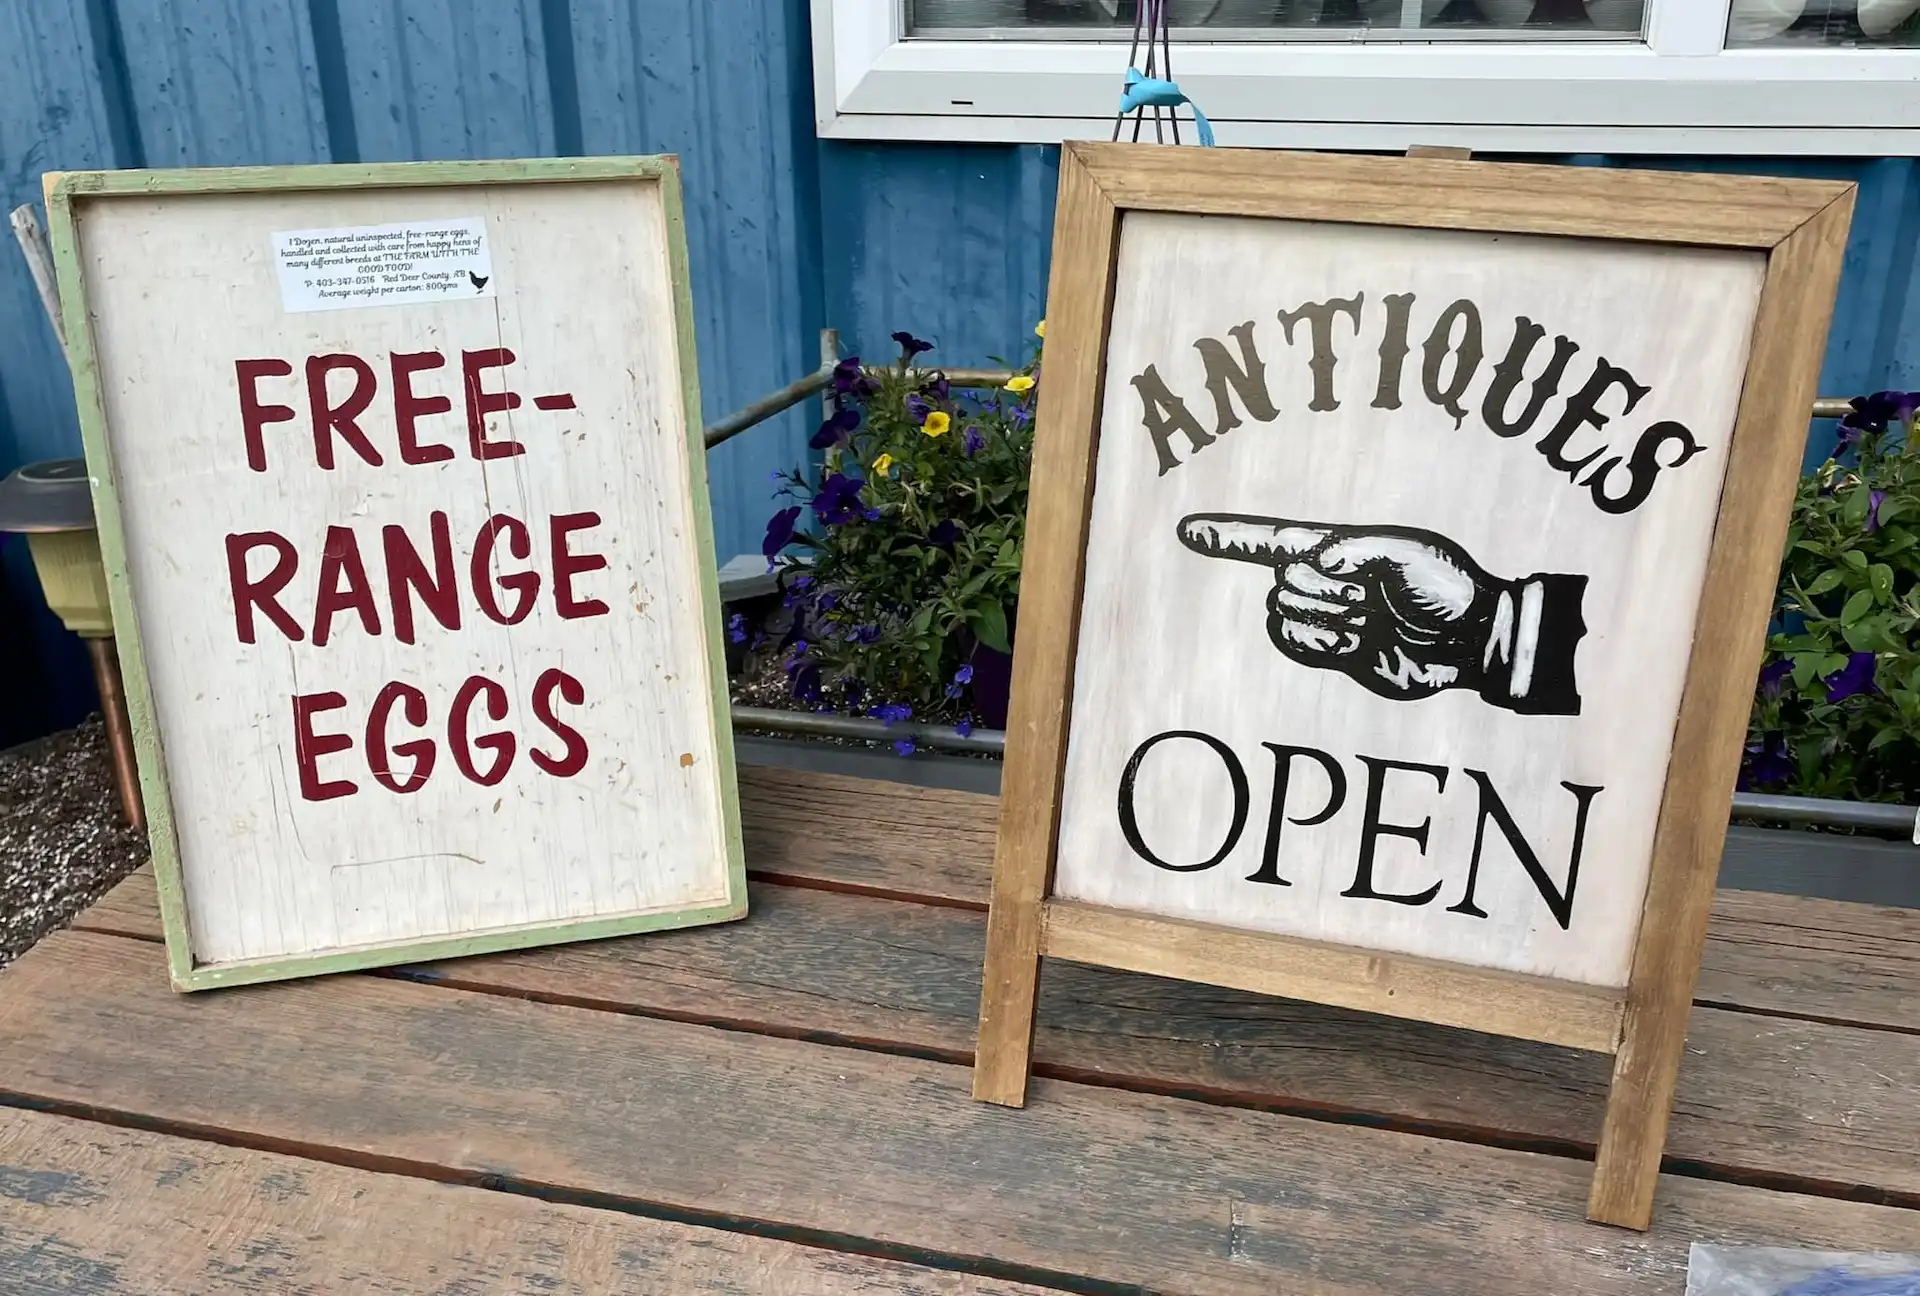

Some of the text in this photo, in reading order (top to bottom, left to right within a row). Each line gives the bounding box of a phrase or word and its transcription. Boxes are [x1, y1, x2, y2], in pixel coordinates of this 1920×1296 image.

[281, 236, 482, 257] handled and collected with care from happy hens of
[324, 233, 354, 244] natural
[406, 229, 448, 241] free-range
[286, 247, 480, 269] many different breeds at THE FARM WITH THE
[358, 264, 384, 274] GOOD
[382, 274, 399, 283] Red
[400, 273, 420, 281] Deer
[454, 269, 466, 278] AB
[318, 288, 352, 299] Average
[352, 286, 379, 298] weight
[381, 285, 395, 296] per
[426, 281, 458, 292] 800gms
[239, 350, 574, 470] FREE-
[1129, 290, 1708, 514] ANTIQUES
[227, 512, 609, 645] RANGE
[294, 669, 589, 801] EGGS
[1118, 730, 1605, 931] OPEN
